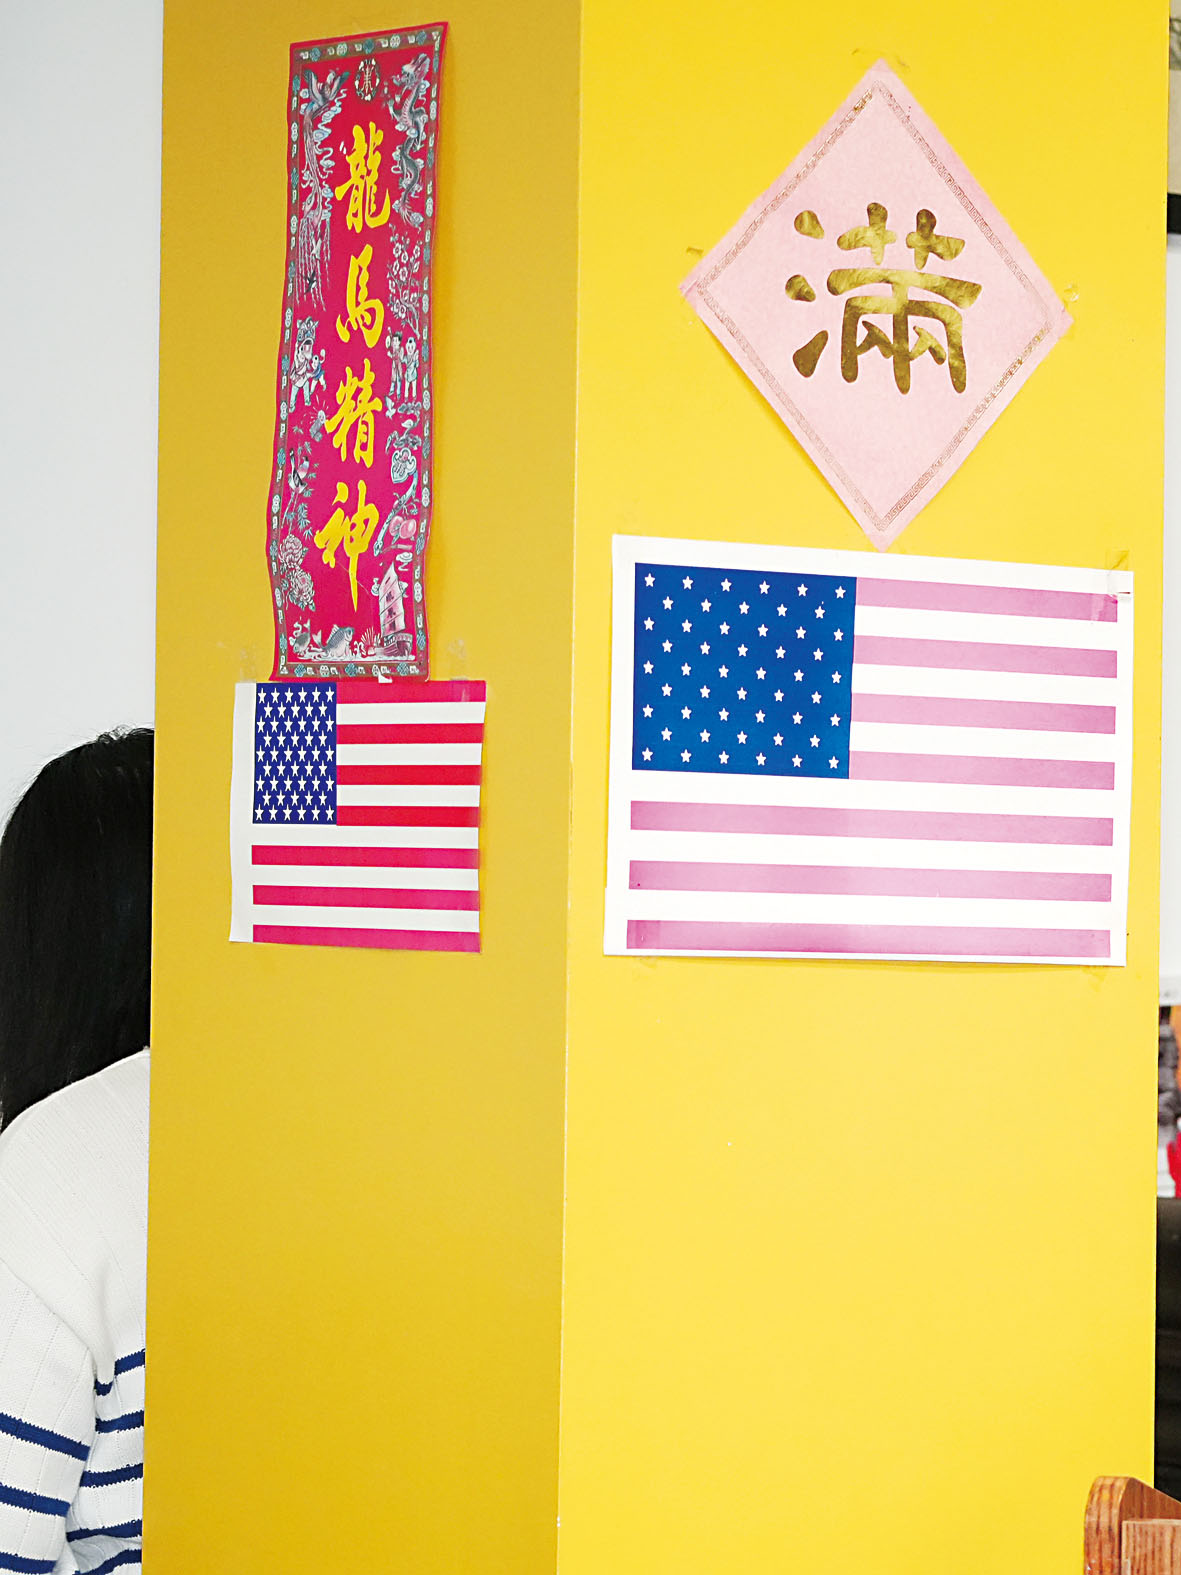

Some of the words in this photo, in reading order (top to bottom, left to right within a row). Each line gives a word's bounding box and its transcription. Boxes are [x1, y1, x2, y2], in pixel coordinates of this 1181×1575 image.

[315, 122, 390, 612] 龍馬精神
[785, 202, 982, 395] 滿
